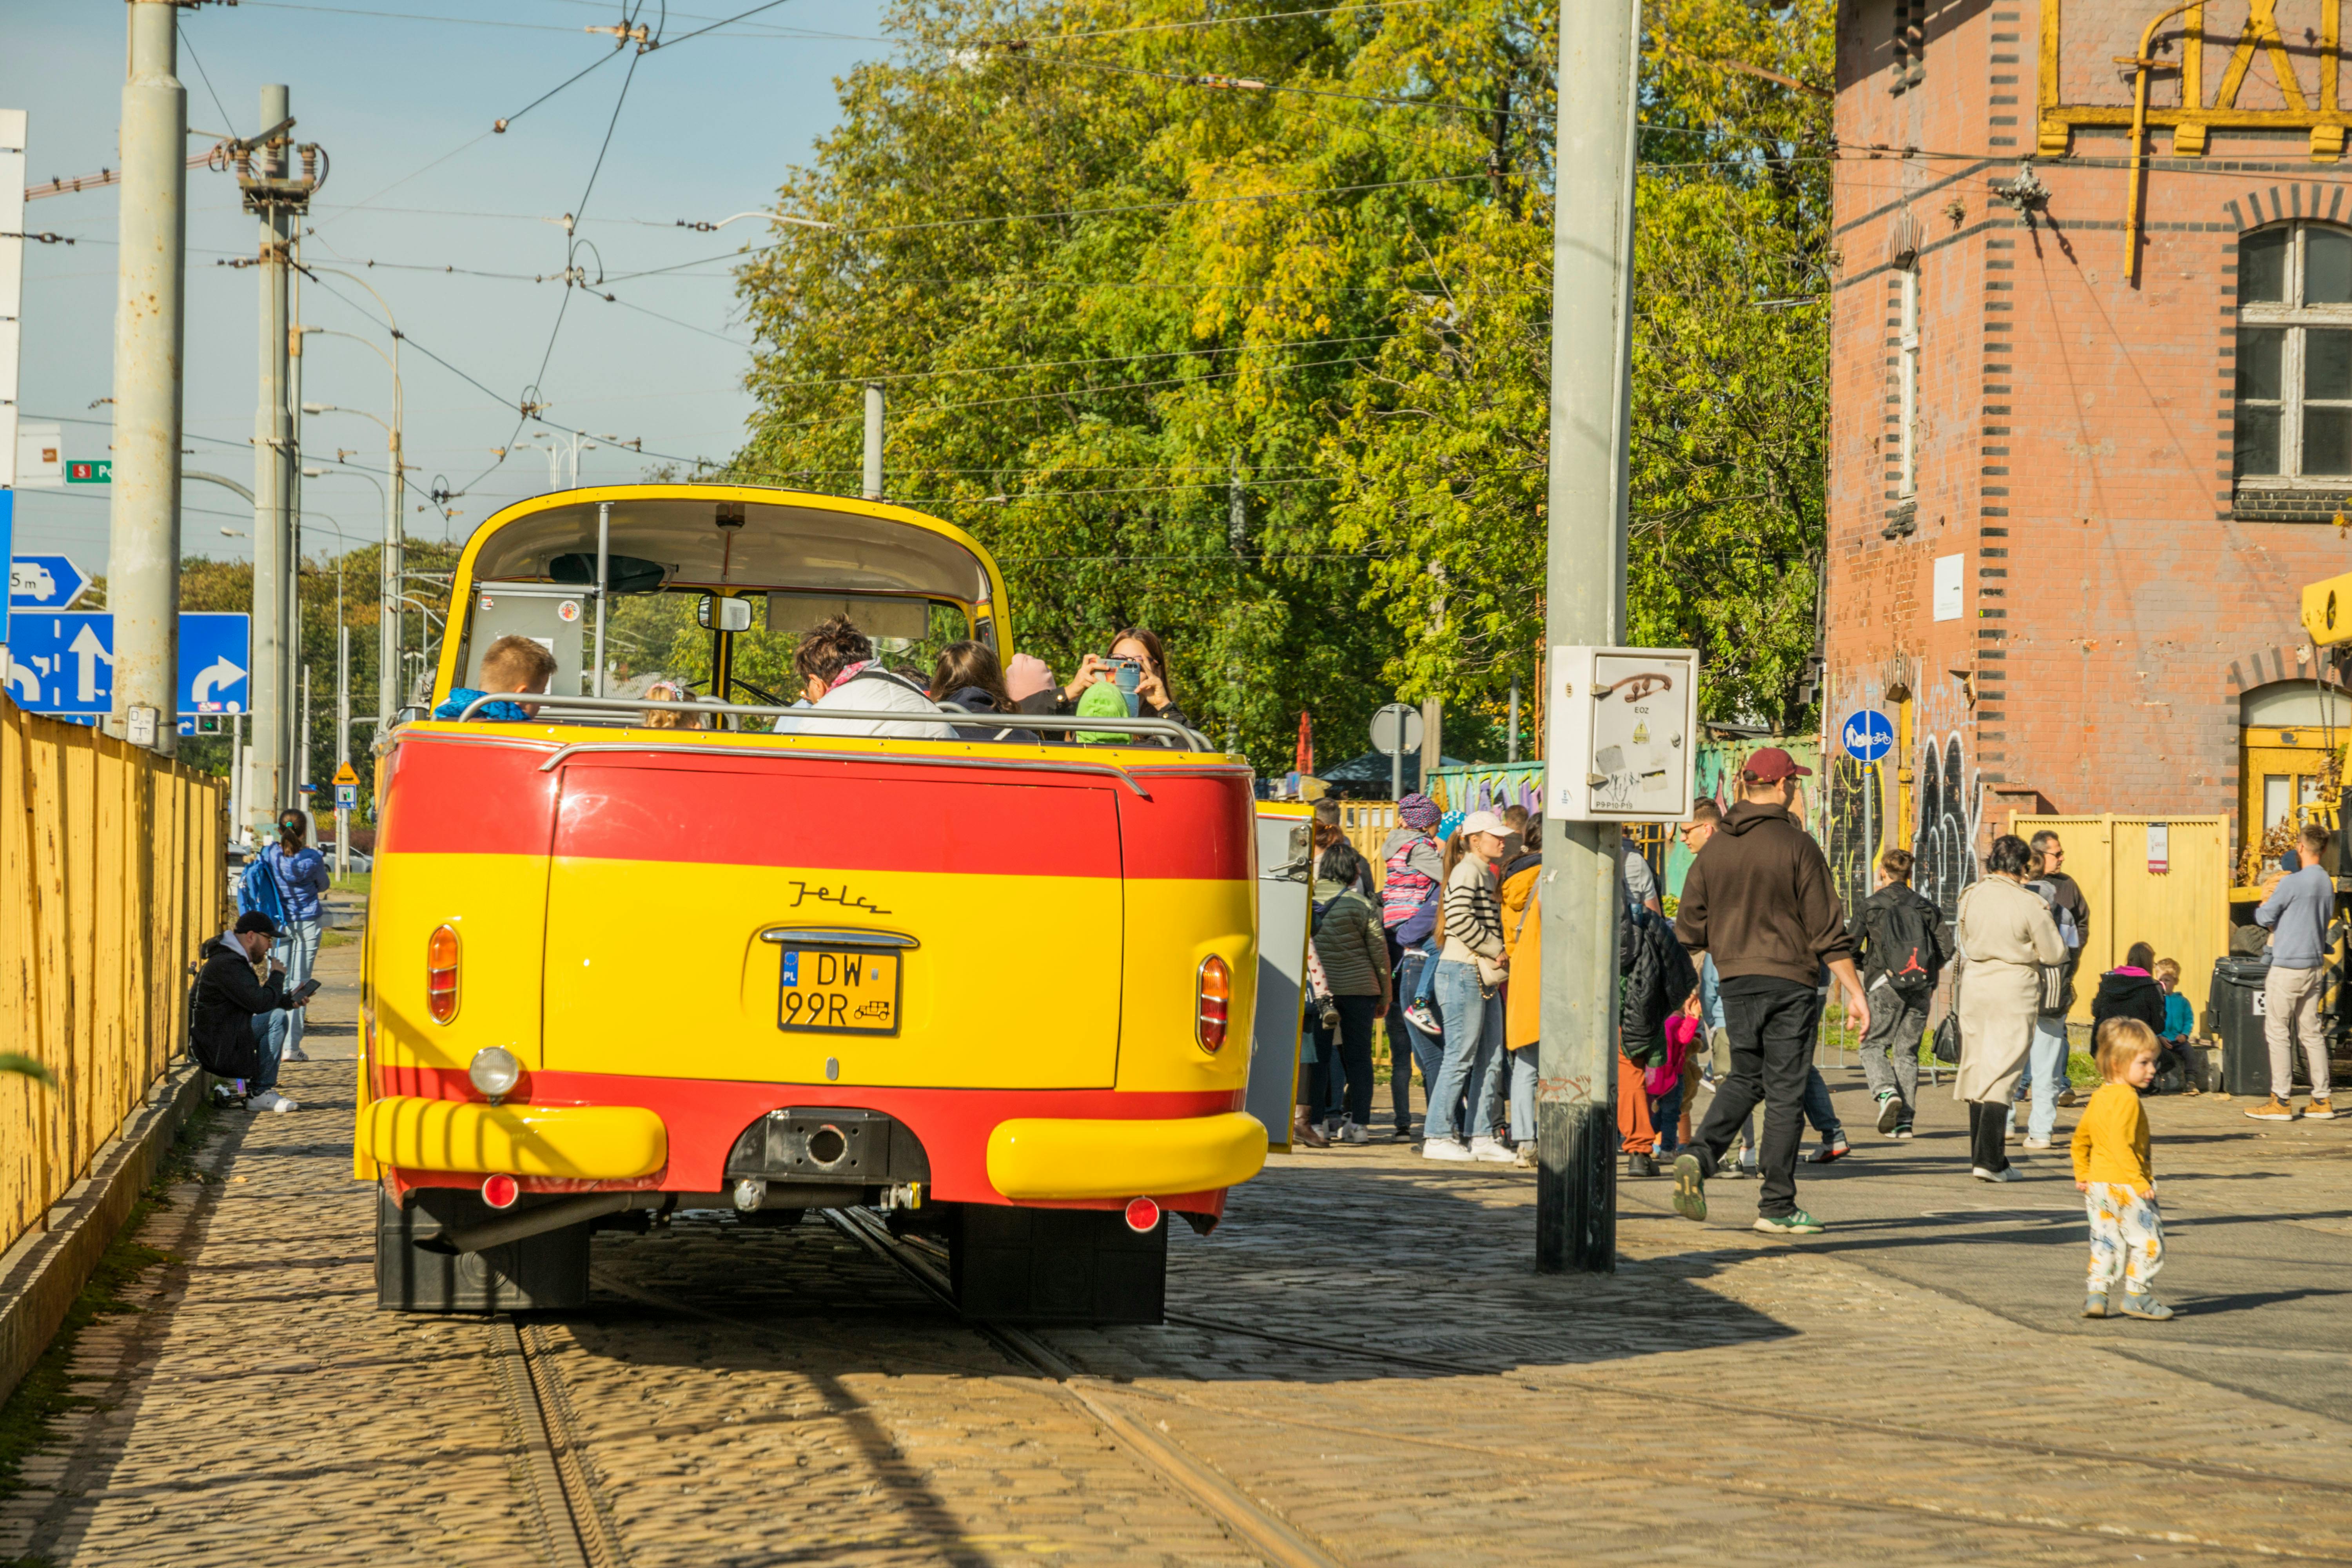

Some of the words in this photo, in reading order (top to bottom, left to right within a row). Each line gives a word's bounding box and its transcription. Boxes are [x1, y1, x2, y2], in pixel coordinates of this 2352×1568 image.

[789, 881, 892, 914] Jelcz
[784, 971, 796, 982] PL
[817, 954, 862, 987] DW
[784, 992, 848, 1025] 99R
